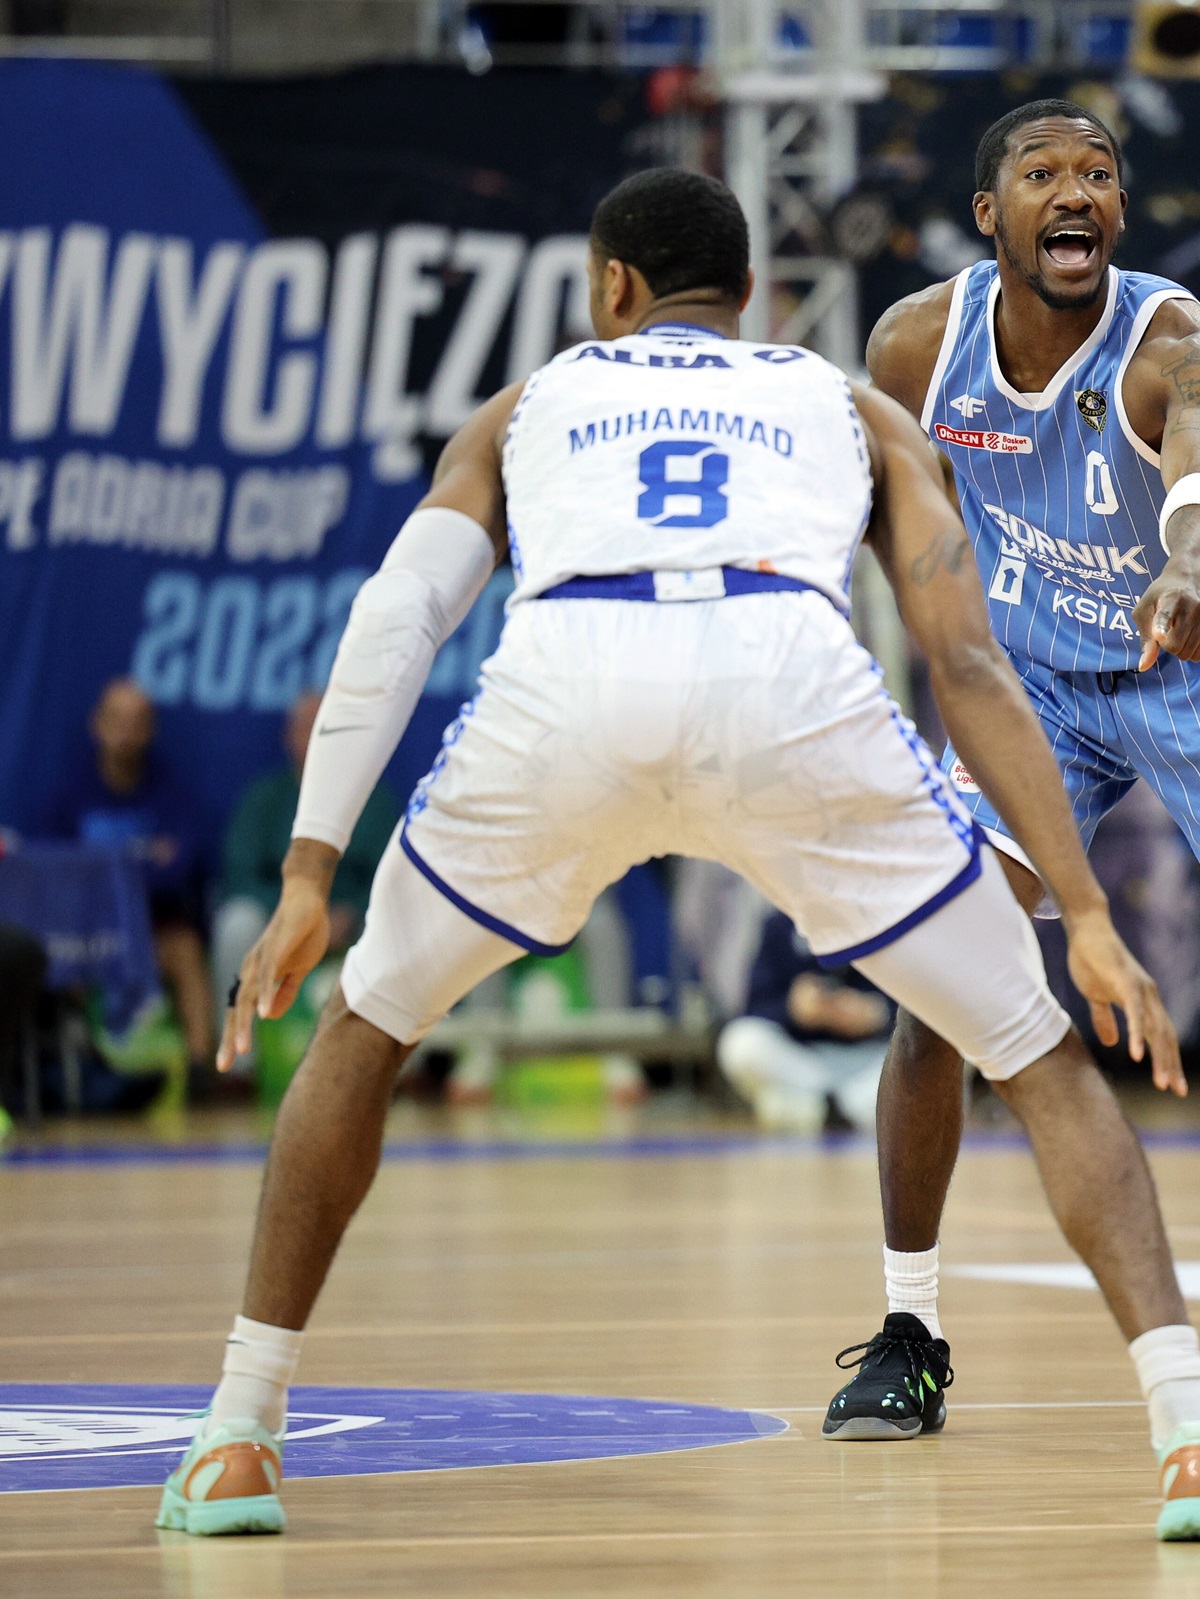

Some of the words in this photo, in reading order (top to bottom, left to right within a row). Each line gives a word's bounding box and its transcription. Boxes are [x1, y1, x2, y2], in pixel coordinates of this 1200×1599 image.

[0, 222, 592, 482] WYCIĘZC
[572, 346, 732, 369] ALBA
[949, 393, 987, 419] 4F
[569, 408, 793, 458] MUHAMMAD
[939, 427, 980, 445] ORLEN
[1001, 443, 1018, 453] Liga
[1002, 435, 1028, 446] Basket
[637, 440, 730, 528] 8
[1085, 449, 1120, 515] 0
[1053, 589, 1140, 640] KSIĄ
